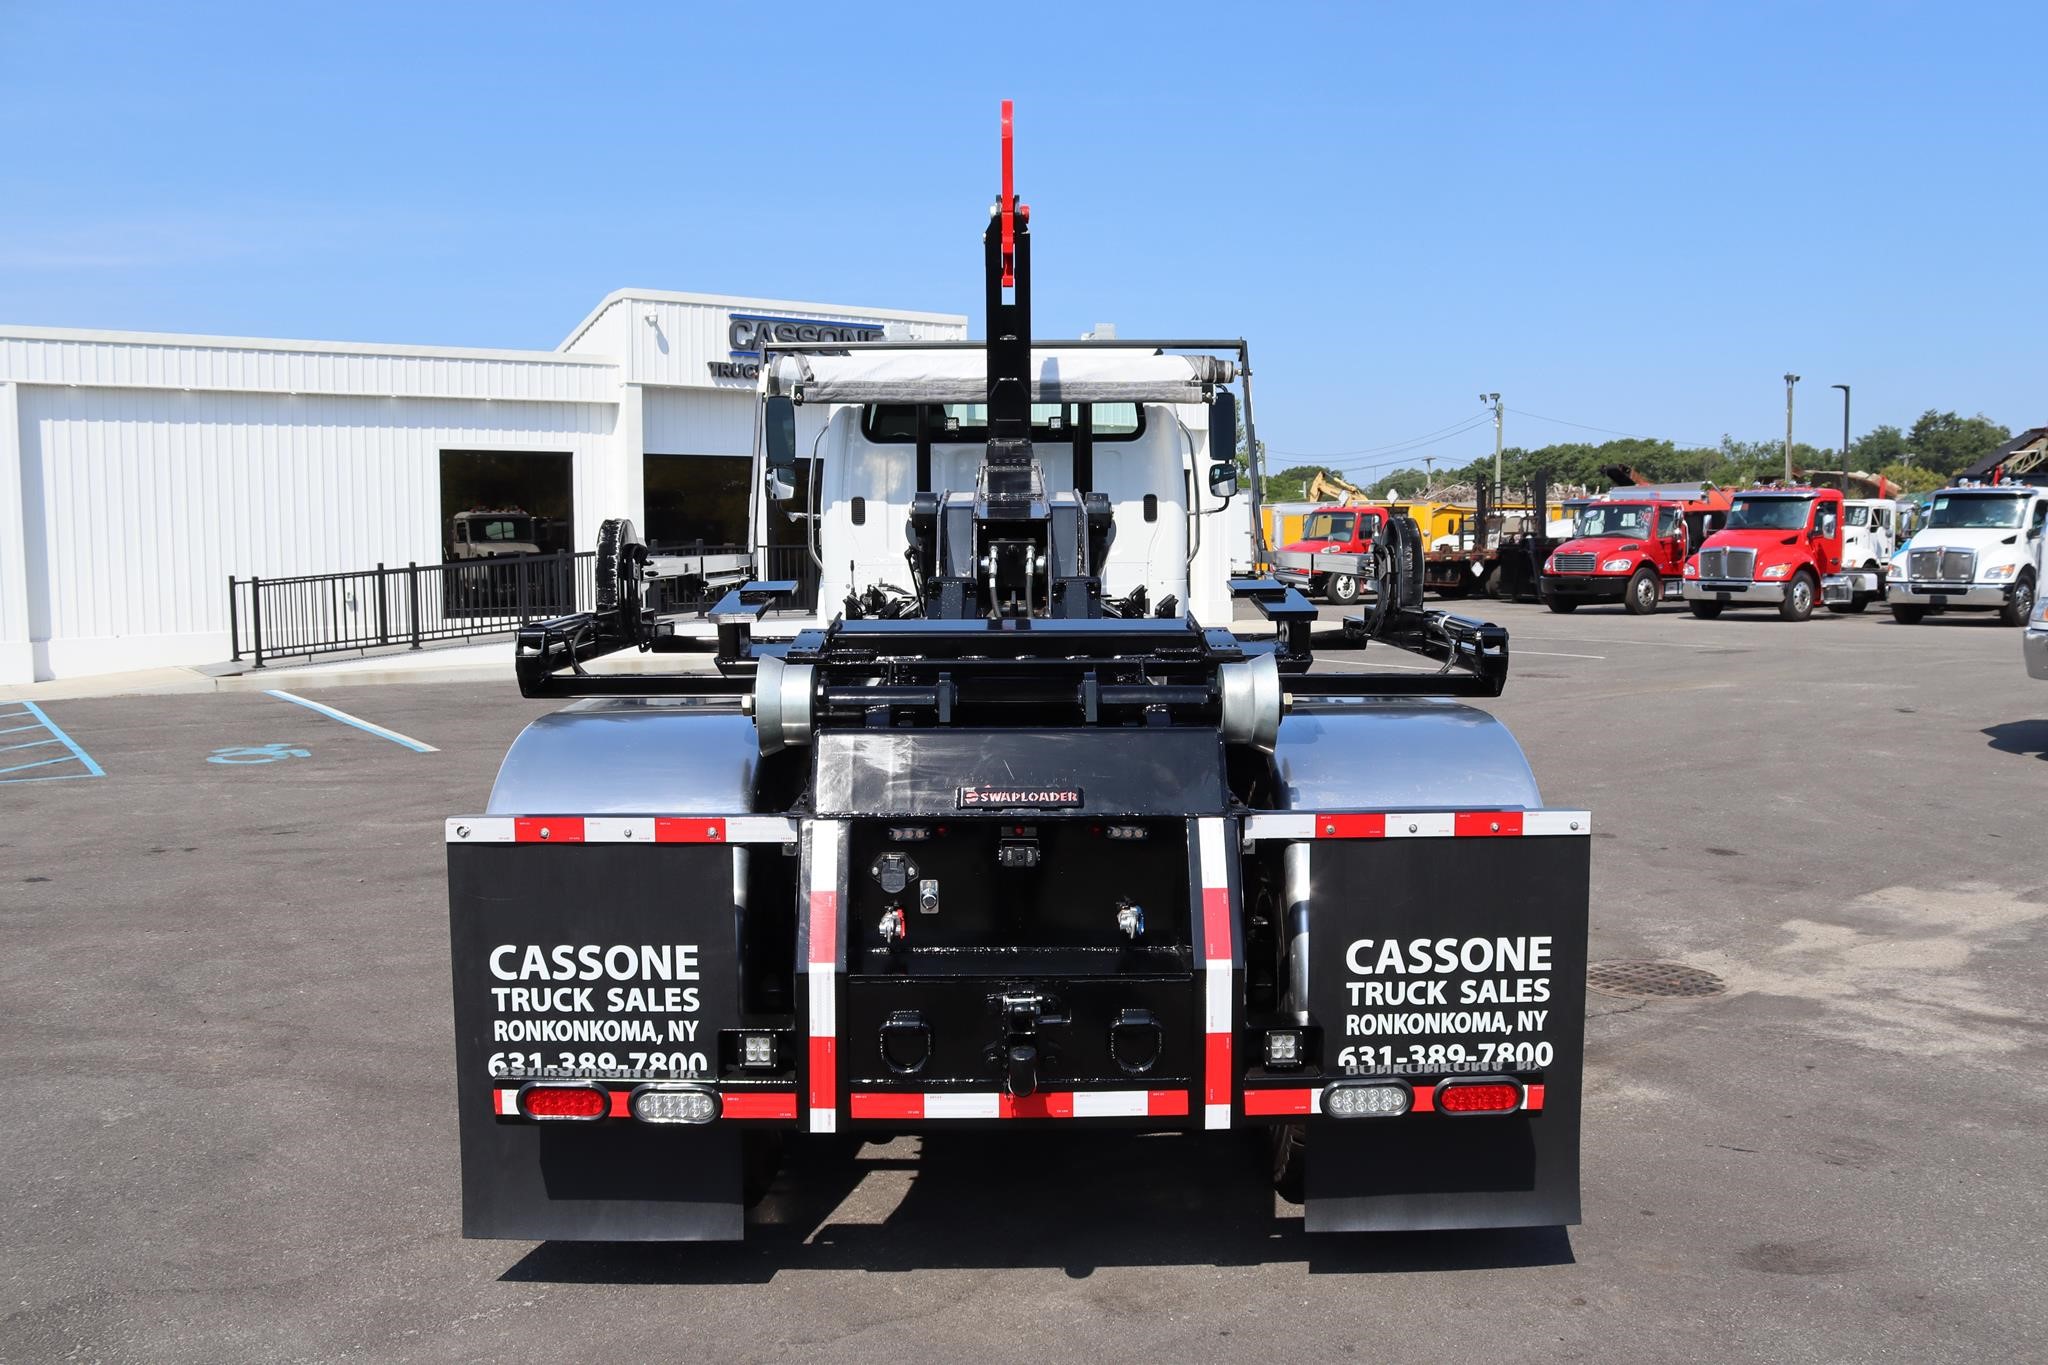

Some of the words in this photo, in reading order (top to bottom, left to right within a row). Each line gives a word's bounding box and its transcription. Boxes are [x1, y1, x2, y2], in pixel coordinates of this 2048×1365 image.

[707, 361, 760, 379] TRUC
[980, 791, 1078, 802] SWAPLOADER
[489, 944, 700, 981] CASSONE
[1345, 935, 1553, 975] CASSONE
[490, 987, 595, 1013] TRUCK
[606, 987, 700, 1013] SALES
[1345, 980, 1448, 1007] TRUCK
[1459, 977, 1551, 1005] SALES
[493, 1019, 664, 1046] RONKONKOMA,
[667, 1020, 700, 1042] NY
[1346, 1010, 1513, 1036] RONKONKOMA,
[1517, 1009, 1549, 1032] NY
[487, 1051, 708, 1077] 631-389-7800
[1337, 1041, 1554, 1067] 631-389-7800
